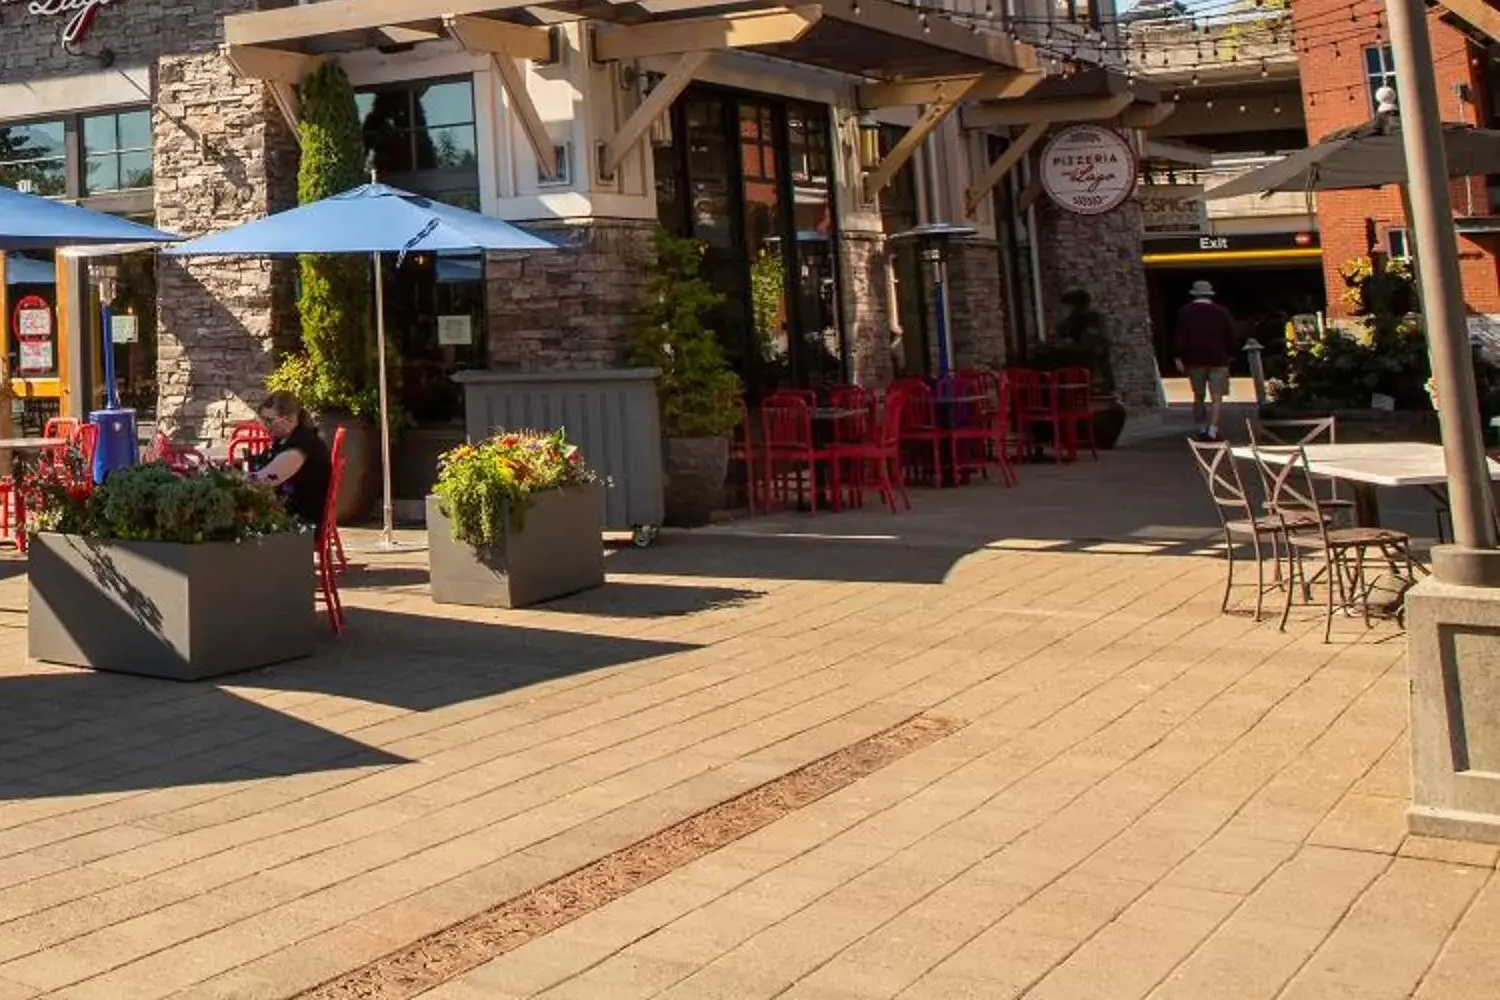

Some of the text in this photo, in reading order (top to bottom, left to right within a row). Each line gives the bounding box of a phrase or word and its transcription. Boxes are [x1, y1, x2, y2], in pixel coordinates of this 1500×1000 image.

[1053, 153, 1117, 166] PIZZERIA
[1070, 163, 1116, 193] Lago
[1199, 237, 1228, 249] Exit
